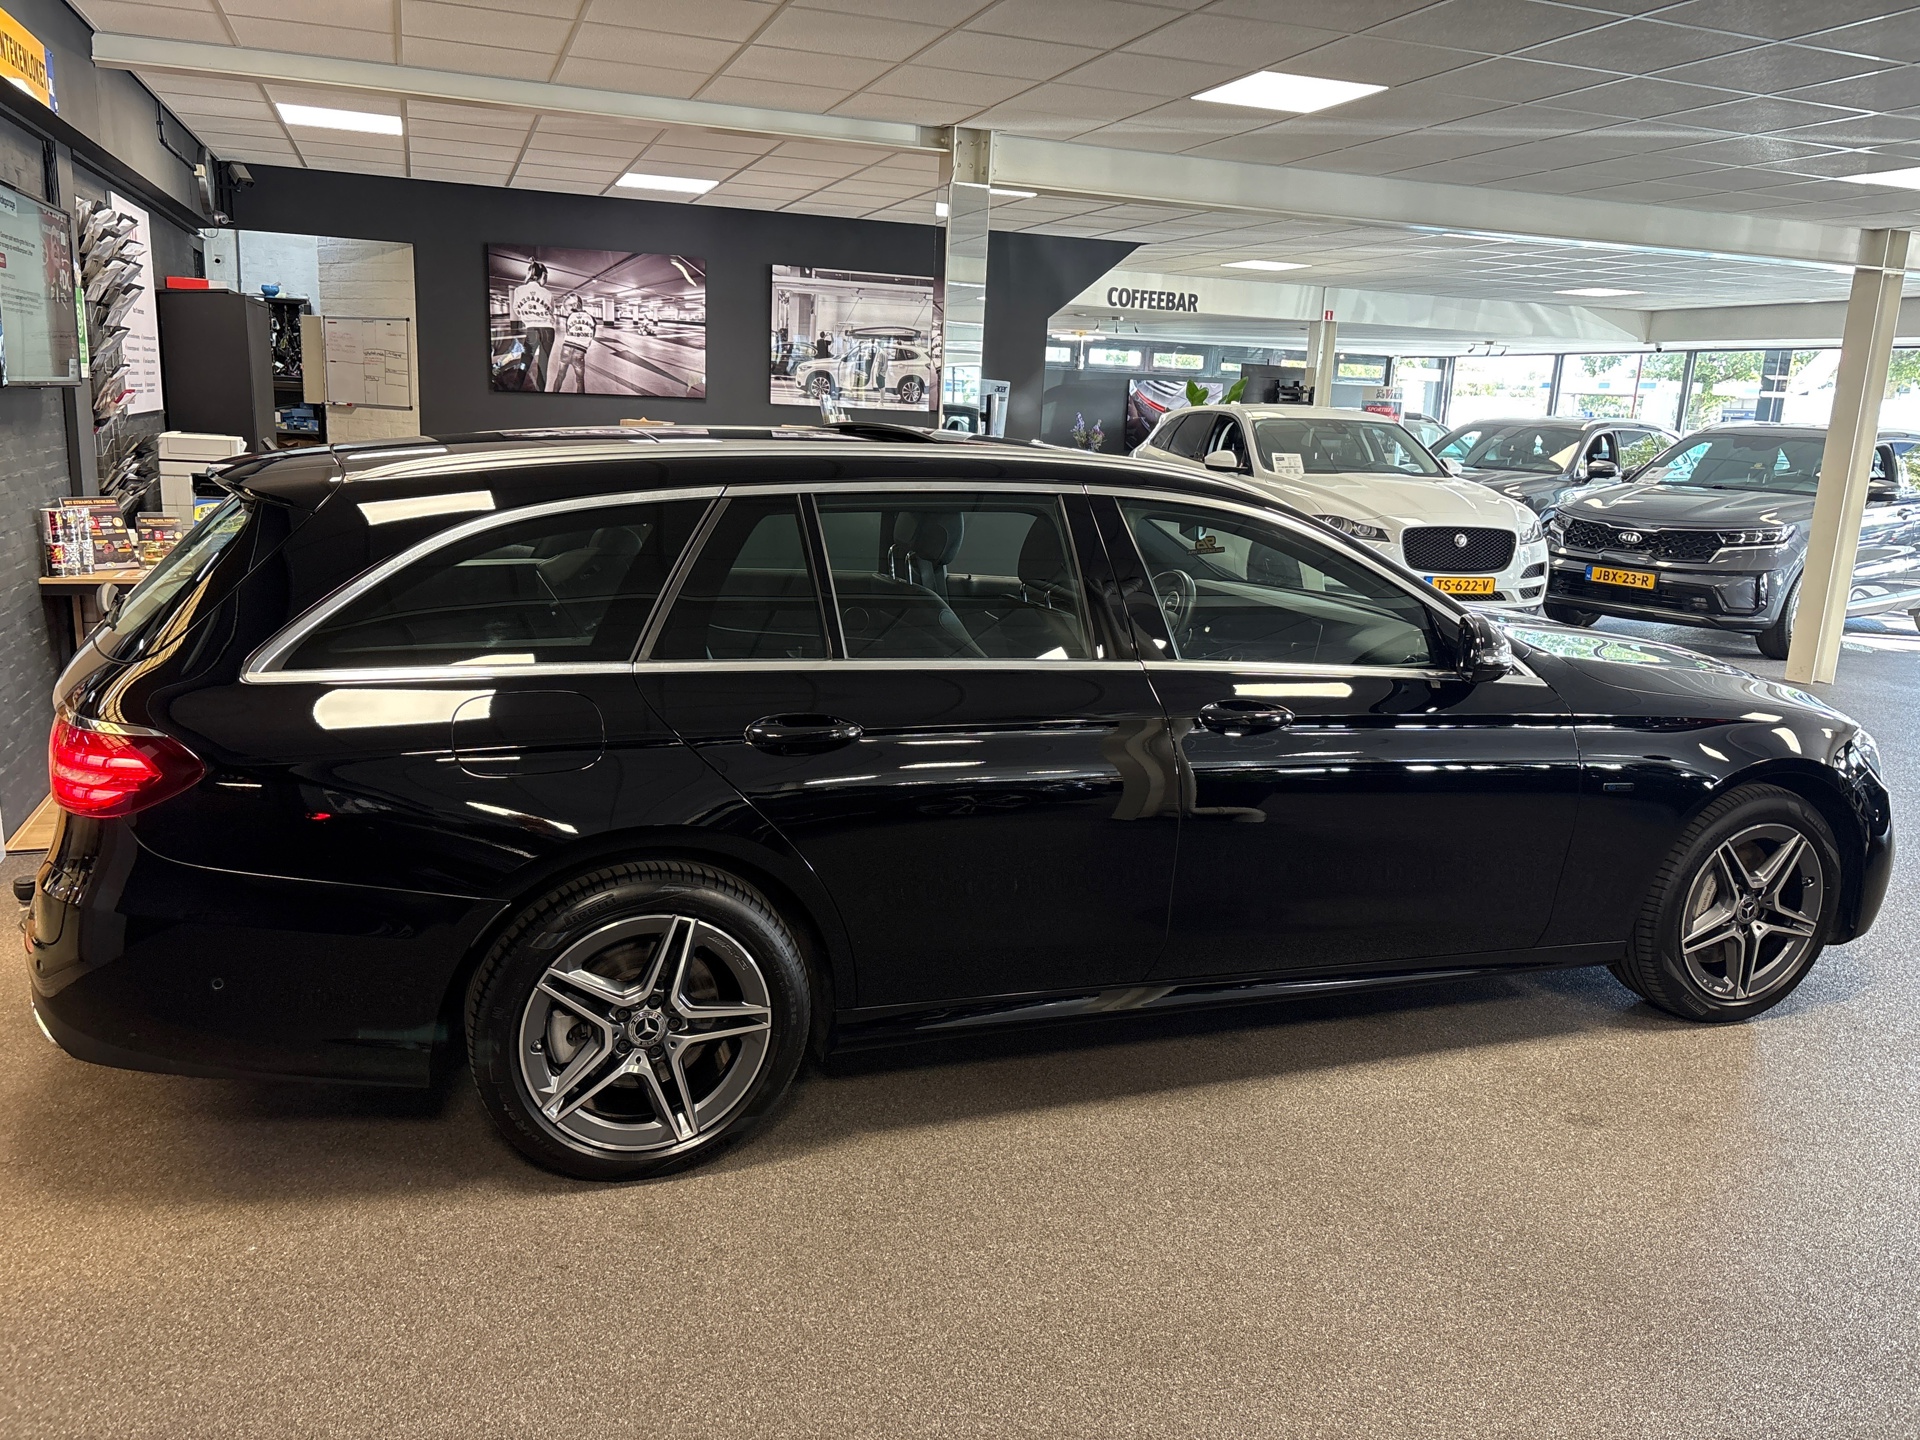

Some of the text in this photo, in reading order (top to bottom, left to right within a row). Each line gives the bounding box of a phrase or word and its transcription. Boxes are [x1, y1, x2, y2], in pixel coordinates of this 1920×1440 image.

[1107, 287, 1199, 312] COFFEEBAR
[994, 385, 1008, 393] acer
[1621, 533, 1638, 542] KIA
[1596, 569, 1649, 587] JBX-23-R
[1436, 579, 1490, 592] TS-622-V
